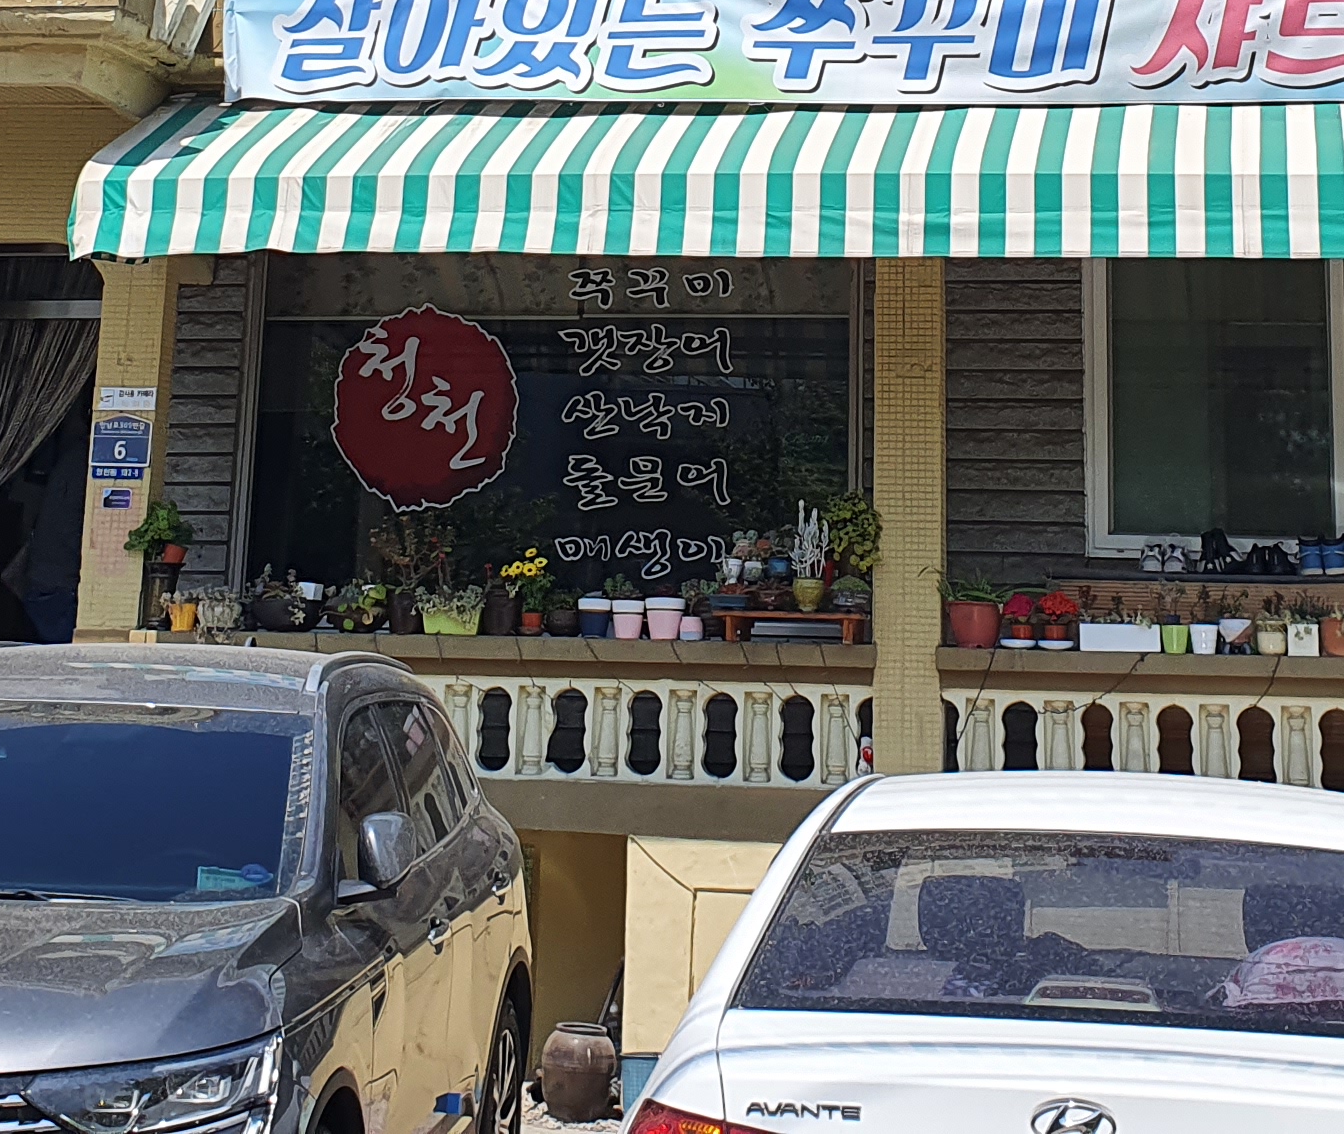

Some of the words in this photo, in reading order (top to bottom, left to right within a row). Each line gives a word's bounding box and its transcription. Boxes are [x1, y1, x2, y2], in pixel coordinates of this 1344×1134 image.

[558, 323, 734, 377] 갯장어
[356, 325, 487, 470] 청천
[561, 390, 730, 440] 산낙지
[114, 440, 127, 460] 6
[562, 455, 731, 511] 돌문어
[746, 1101, 861, 1121] AVANTE
